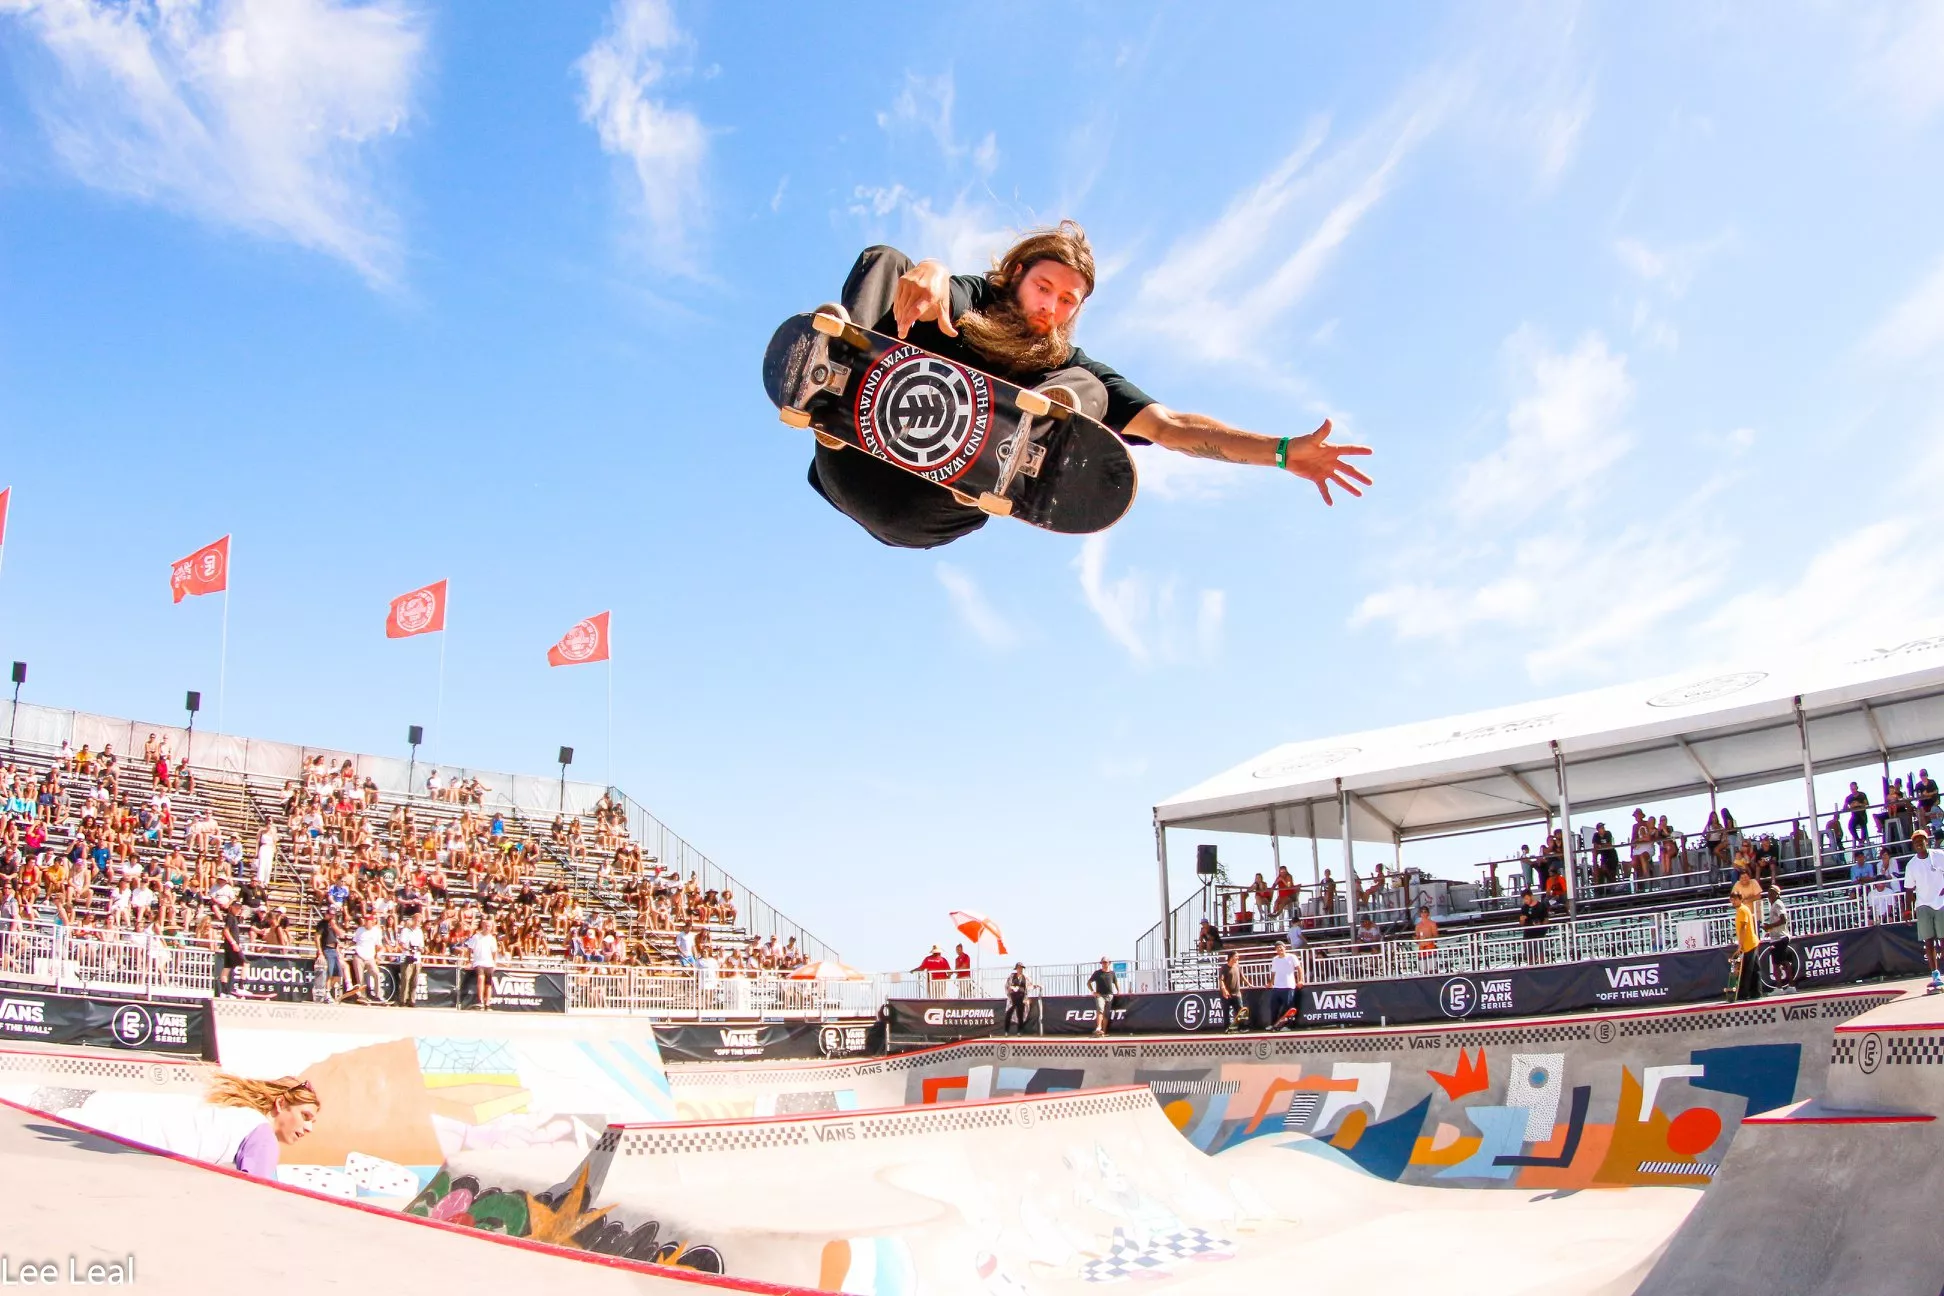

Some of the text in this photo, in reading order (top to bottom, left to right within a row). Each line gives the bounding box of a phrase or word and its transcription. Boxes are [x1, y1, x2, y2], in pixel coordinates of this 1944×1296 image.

[860, 369, 883, 410] WIND
[880, 345, 924, 369] WATE
[965, 367, 989, 408] ARTH
[963, 414, 989, 456] WIND
[1804, 942, 1839, 960] VANS
[1805, 957, 1841, 971] PARK
[1605, 963, 1660, 989] VANS
[1806, 967, 1841, 978] SERIES
[233, 982, 308, 993] SWISS MAD
[491, 976, 536, 996] VANS
[1481, 979, 1512, 993] VANS
[1312, 989, 1357, 1010] VANS
[1481, 992, 1512, 1003] PARK
[1620, 990, 1639, 999] THE
[1481, 1001, 1513, 1010] SERIES
[1782, 1003, 1817, 1021] VANS
[155, 1012, 188, 1027] VANS
[945, 1009, 995, 1018] CALIFORNIA
[1323, 1012, 1338, 1020] THE
[5, 1023, 23, 1032] THE
[944, 1018, 995, 1026] skateparks
[155, 1026, 188, 1037] PARK
[720, 1029, 758, 1047] VANS
[845, 1028, 866, 1038] VANS
[155, 1035, 188, 1044] SERIES
[845, 1038, 866, 1046] PARK
[1408, 1035, 1441, 1049] VANS
[730, 1048, 744, 1056] THE
[1112, 1045, 1137, 1057] VANS
[853, 1063, 882, 1077] VANS
[813, 1122, 856, 1143] VANS
